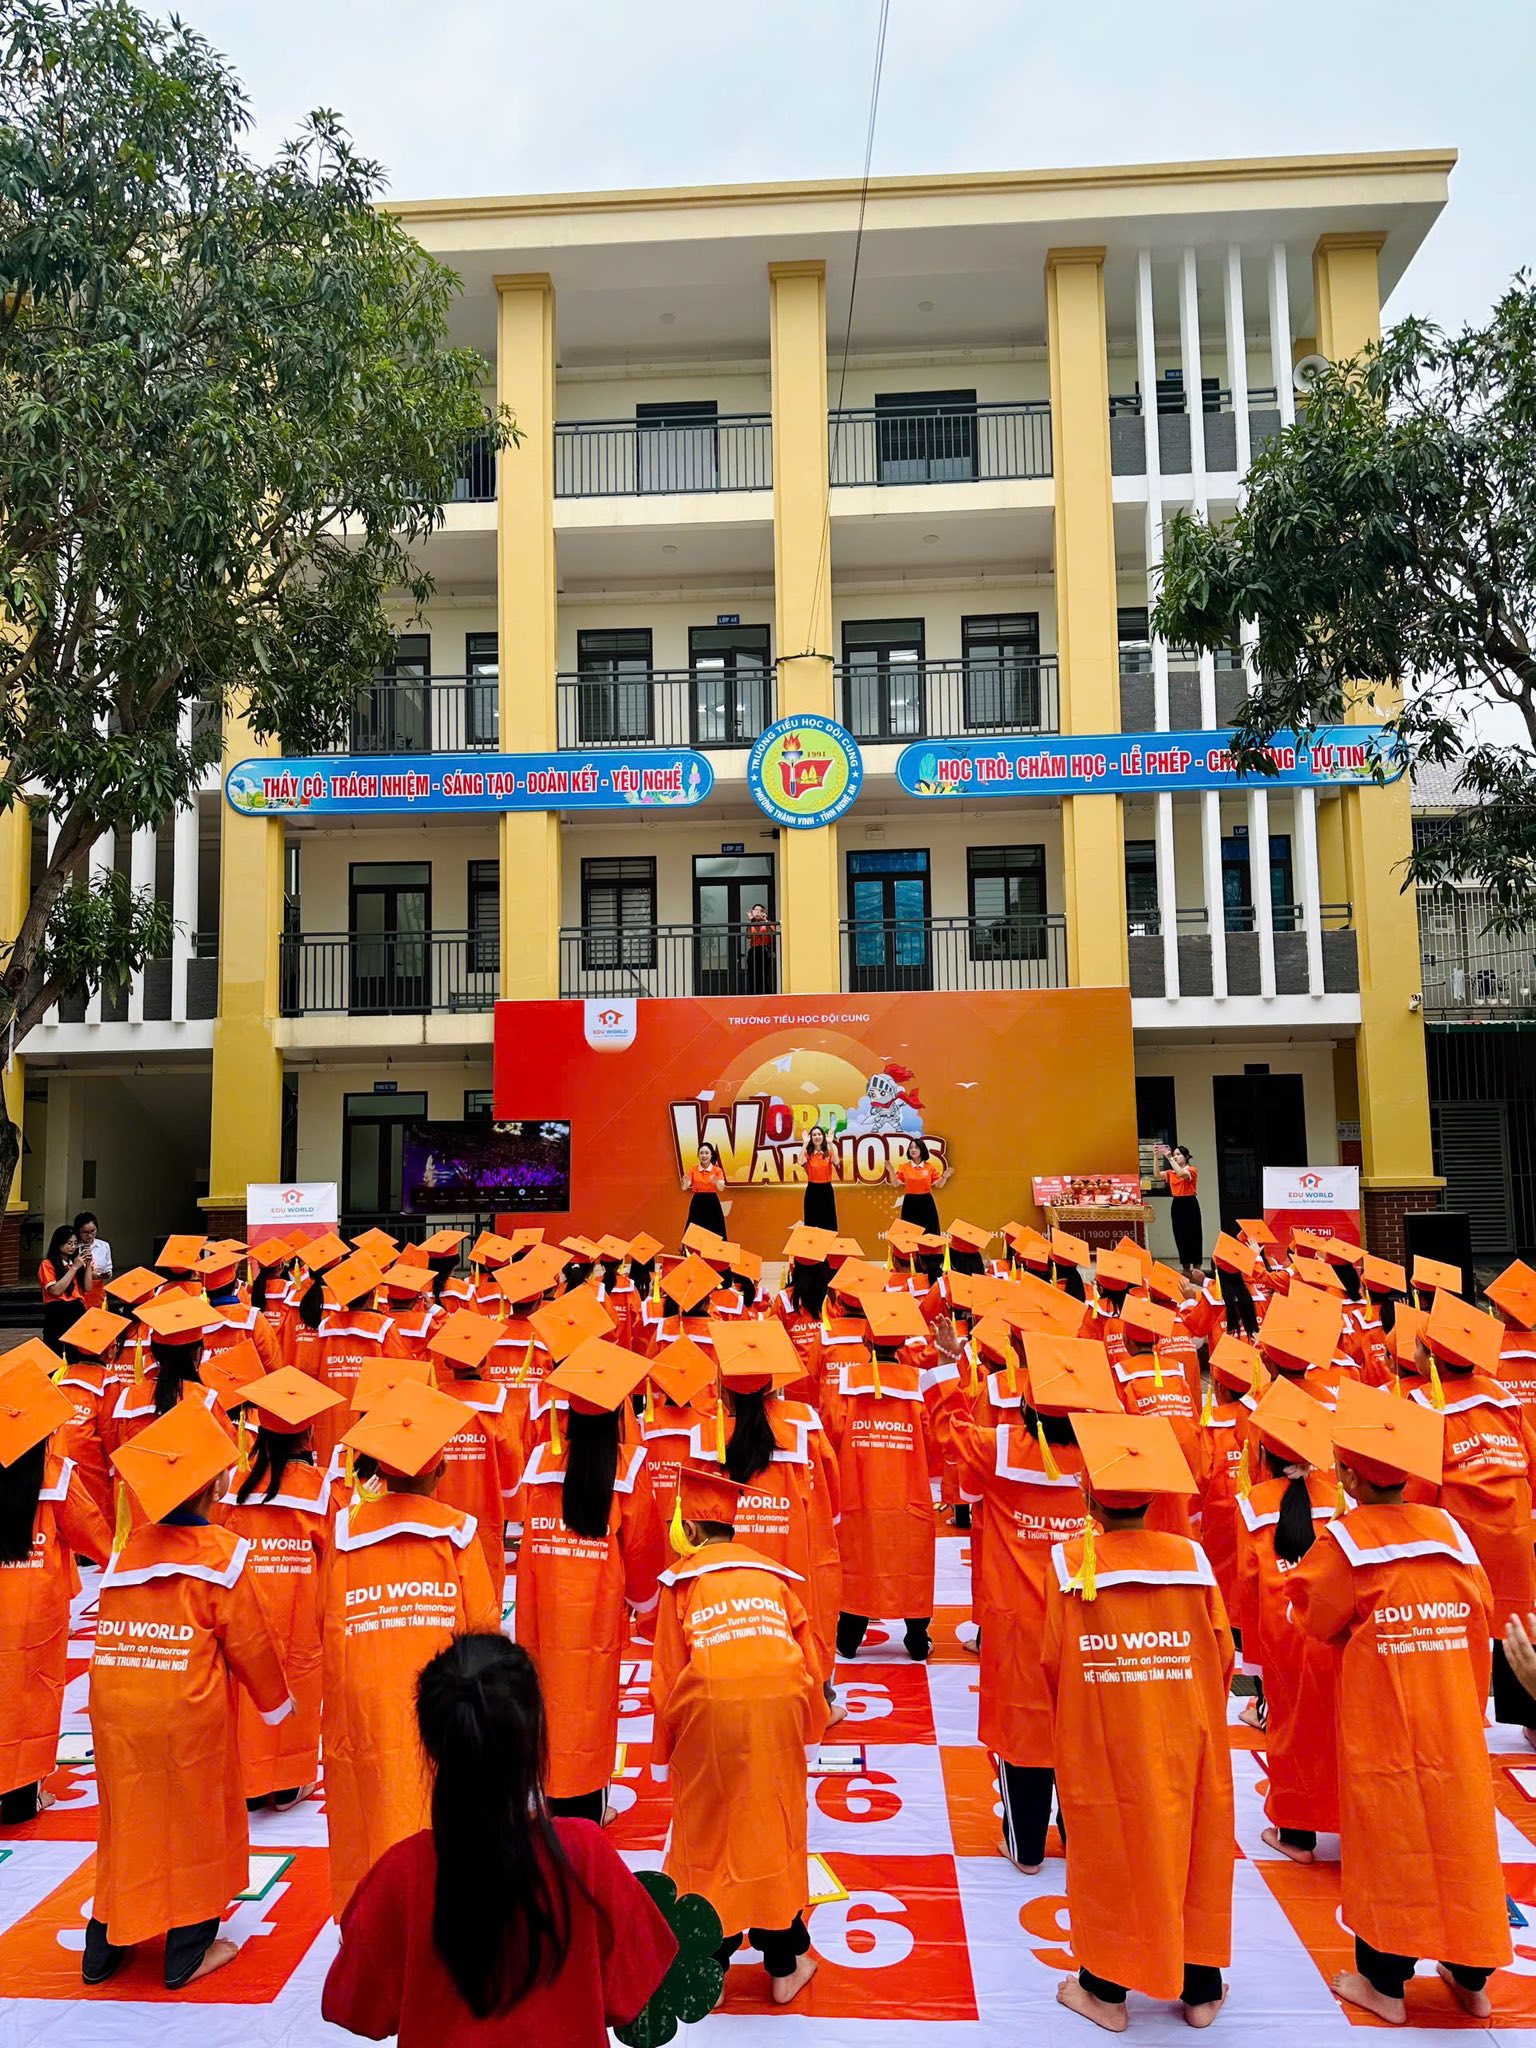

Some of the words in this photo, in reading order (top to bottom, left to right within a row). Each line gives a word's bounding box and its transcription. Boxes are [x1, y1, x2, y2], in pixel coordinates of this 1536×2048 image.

[752, 731, 776, 770] TRƯỜNG
[775, 718, 798, 734] TIỂU
[801, 718, 824, 728] HỌC
[825, 723, 844, 740] ĐỘI
[842, 738, 858, 768] CUNG
[937, 758, 972, 785] HỌC
[976, 752, 1013, 780] TRÒ:
[1017, 751, 1066, 778] CHĂM
[1071, 754, 1106, 781] HỌC
[1120, 744, 1142, 775] LỄ
[1145, 747, 1191, 774] PHÉP
[1311, 745, 1334, 774] TỰ
[1337, 746, 1366, 769] TIN
[262, 769, 299, 798] THẦY
[302, 773, 327, 798] CÔ:
[331, 771, 378, 798] TRÁCH
[381, 770, 430, 801] NHIỆM
[443, 769, 483, 796] SÁNG
[486, 772, 514, 799] TẠO
[527, 767, 569, 793] ĐOÀN
[571, 764, 598, 792] KẾT
[611, 765, 640, 792] YÊU
[642, 761, 682, 791] NGHỀ
[754, 787, 775, 816] PHƯỜNG
[774, 810, 796, 824] THÀNH
[797, 816, 815, 825] VINH
[820, 810, 838, 822] TỈNH
[834, 794, 854, 814] NGHỆ
[848, 784, 858, 796] AN
[728, 1015, 771, 1025] TRƯỜNG
[773, 1013, 795, 1024] TIỂU
[797, 1014, 819, 1025] HỌC
[821, 1012, 839, 1024] ĐỘI
[841, 1014, 870, 1022] CUNG
[1089, 1230, 1110, 1238] 1900
[114, 1364, 134, 1372] WORL
[490, 1366, 508, 1374] EDU
[1136, 1396, 1157, 1407] EDU
[1158, 1393, 1190, 1404] WORLD
[852, 1420, 871, 1430] EDU
[872, 1421, 914, 1432] WORLD
[1452, 1434, 1480, 1455] EDU
[1226, 1451, 1242, 1460] ED
[736, 1496, 790, 1510] WORLD
[531, 1517, 556, 1530] EDU
[261, 1538, 312, 1552] WORLD
[552, 1535, 566, 1544] Turn
[254, 1554, 270, 1562] Turn
[345, 1585, 382, 1606] EDU
[386, 1581, 457, 1598] WORLD
[378, 1605, 398, 1614] Turn
[400, 1604, 412, 1612] on
[414, 1602, 456, 1613] tomorrow
[691, 1601, 728, 1625] EDU
[1374, 1606, 1413, 1624] EDU
[1416, 1602, 1471, 1620] WORLD
[355, 1618, 380, 1634] THỐNG
[381, 1616, 406, 1629] TRUNG
[408, 1614, 425, 1627] TÂM
[426, 1616, 440, 1626] ANH
[727, 1618, 746, 1626] Turn
[748, 1614, 760, 1622] on
[98, 1620, 126, 1636] EDU
[129, 1621, 194, 1640] WORLD
[694, 1636, 704, 1649] HỆ
[706, 1630, 730, 1646] THỐNG
[732, 1627, 757, 1640] TRUNG
[758, 1625, 774, 1636] TÂM
[1412, 1626, 1433, 1636] Turn
[1079, 1634, 1118, 1651] EDU
[1121, 1630, 1191, 1649] WORLD
[1377, 1641, 1388, 1656] HỆ
[1390, 1640, 1416, 1654] THỐNG
[1416, 1640, 1445, 1652] TRUNG
[118, 1642, 135, 1652] Turn
[150, 1645, 190, 1656] tomorrow
[94, 1653, 116, 1666] THỐNG
[117, 1656, 140, 1668] TRUNG
[142, 1656, 156, 1669] TÂM
[156, 1659, 170, 1670] ANH
[171, 1659, 188, 1671] NGŨ
[1116, 1656, 1138, 1666] Turn
[1140, 1656, 1152, 1664] on
[1084, 1670, 1096, 1684] HỆ
[1096, 1668, 1120, 1682] THỐNG
[1121, 1670, 1148, 1682] TRUNG
[1149, 1668, 1164, 1680] TÂM
[1166, 1668, 1184, 1680] ANH
[815, 1770, 902, 1823] 6
[808, 1891, 914, 1968] 6
